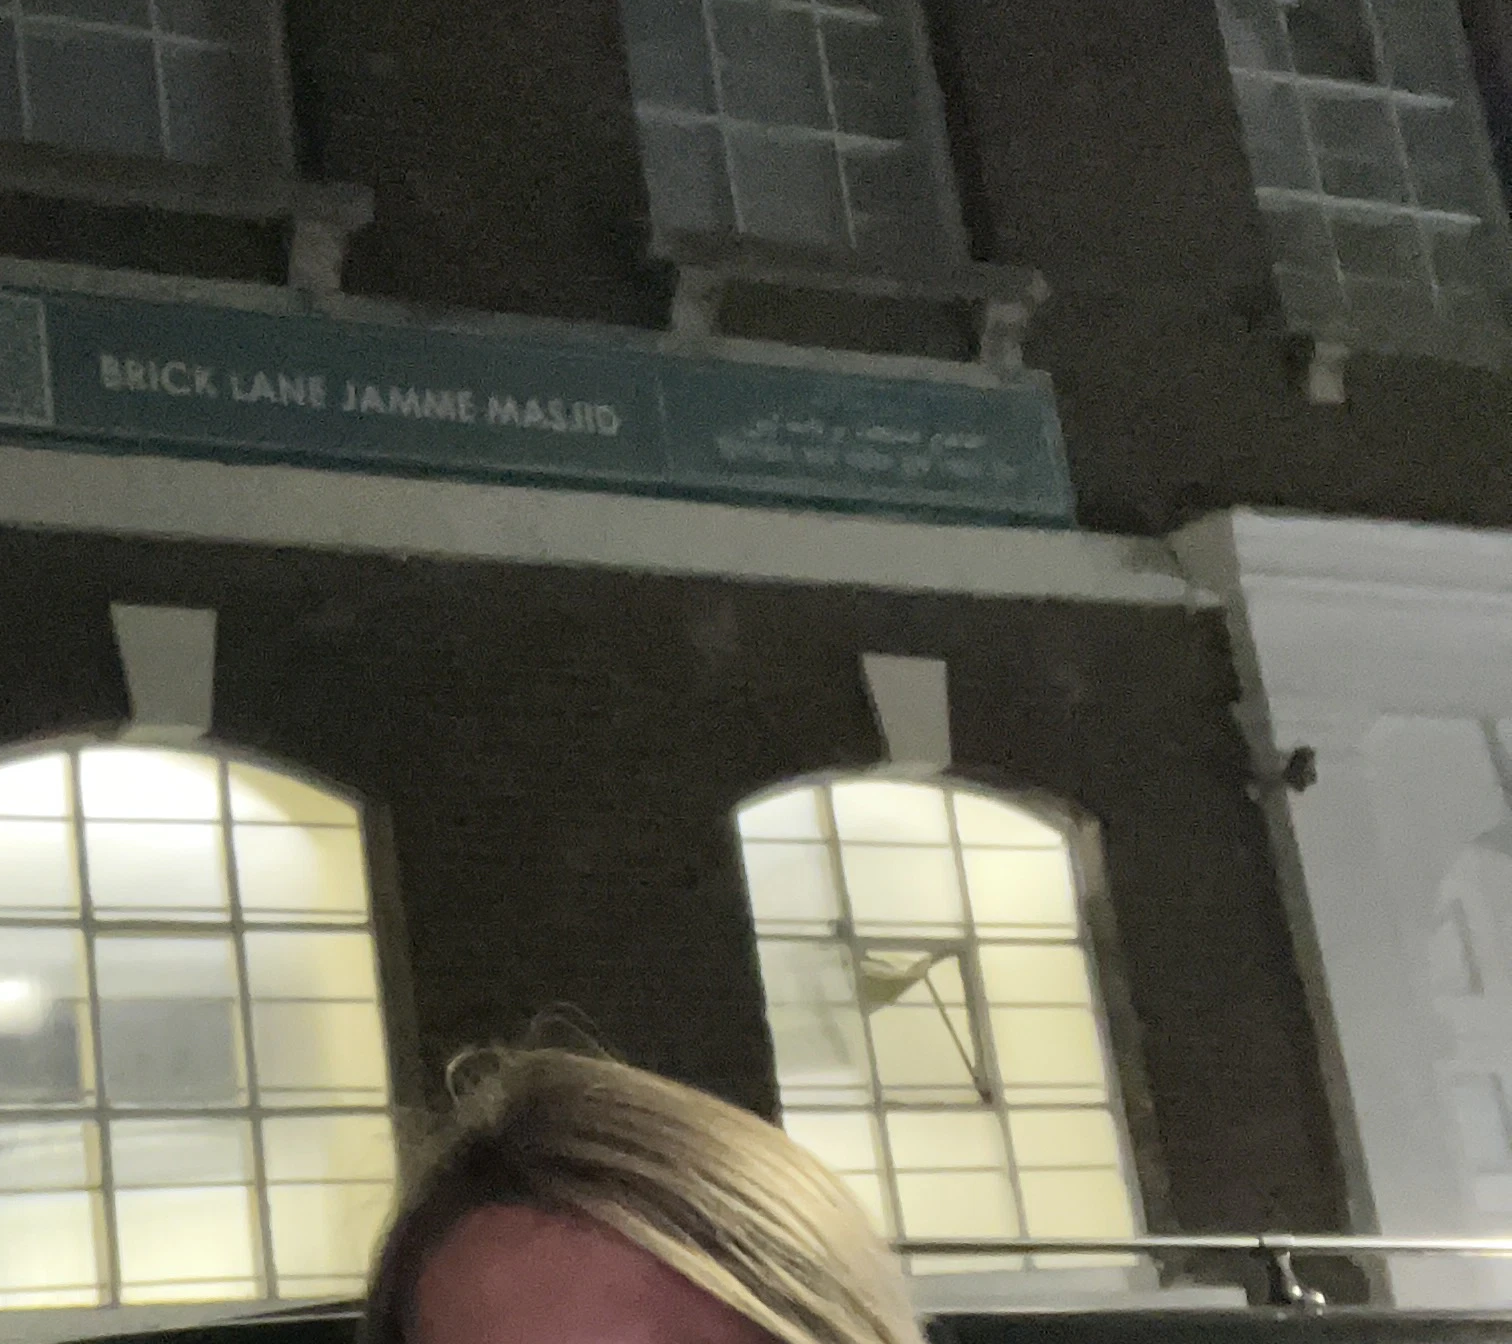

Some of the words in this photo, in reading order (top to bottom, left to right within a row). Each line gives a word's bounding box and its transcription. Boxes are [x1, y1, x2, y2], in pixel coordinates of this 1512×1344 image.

[100, 353, 216, 397] BRICK
[231, 371, 325, 410] LANE
[344, 380, 473, 423] JAMME
[488, 396, 621, 436] MASJID
